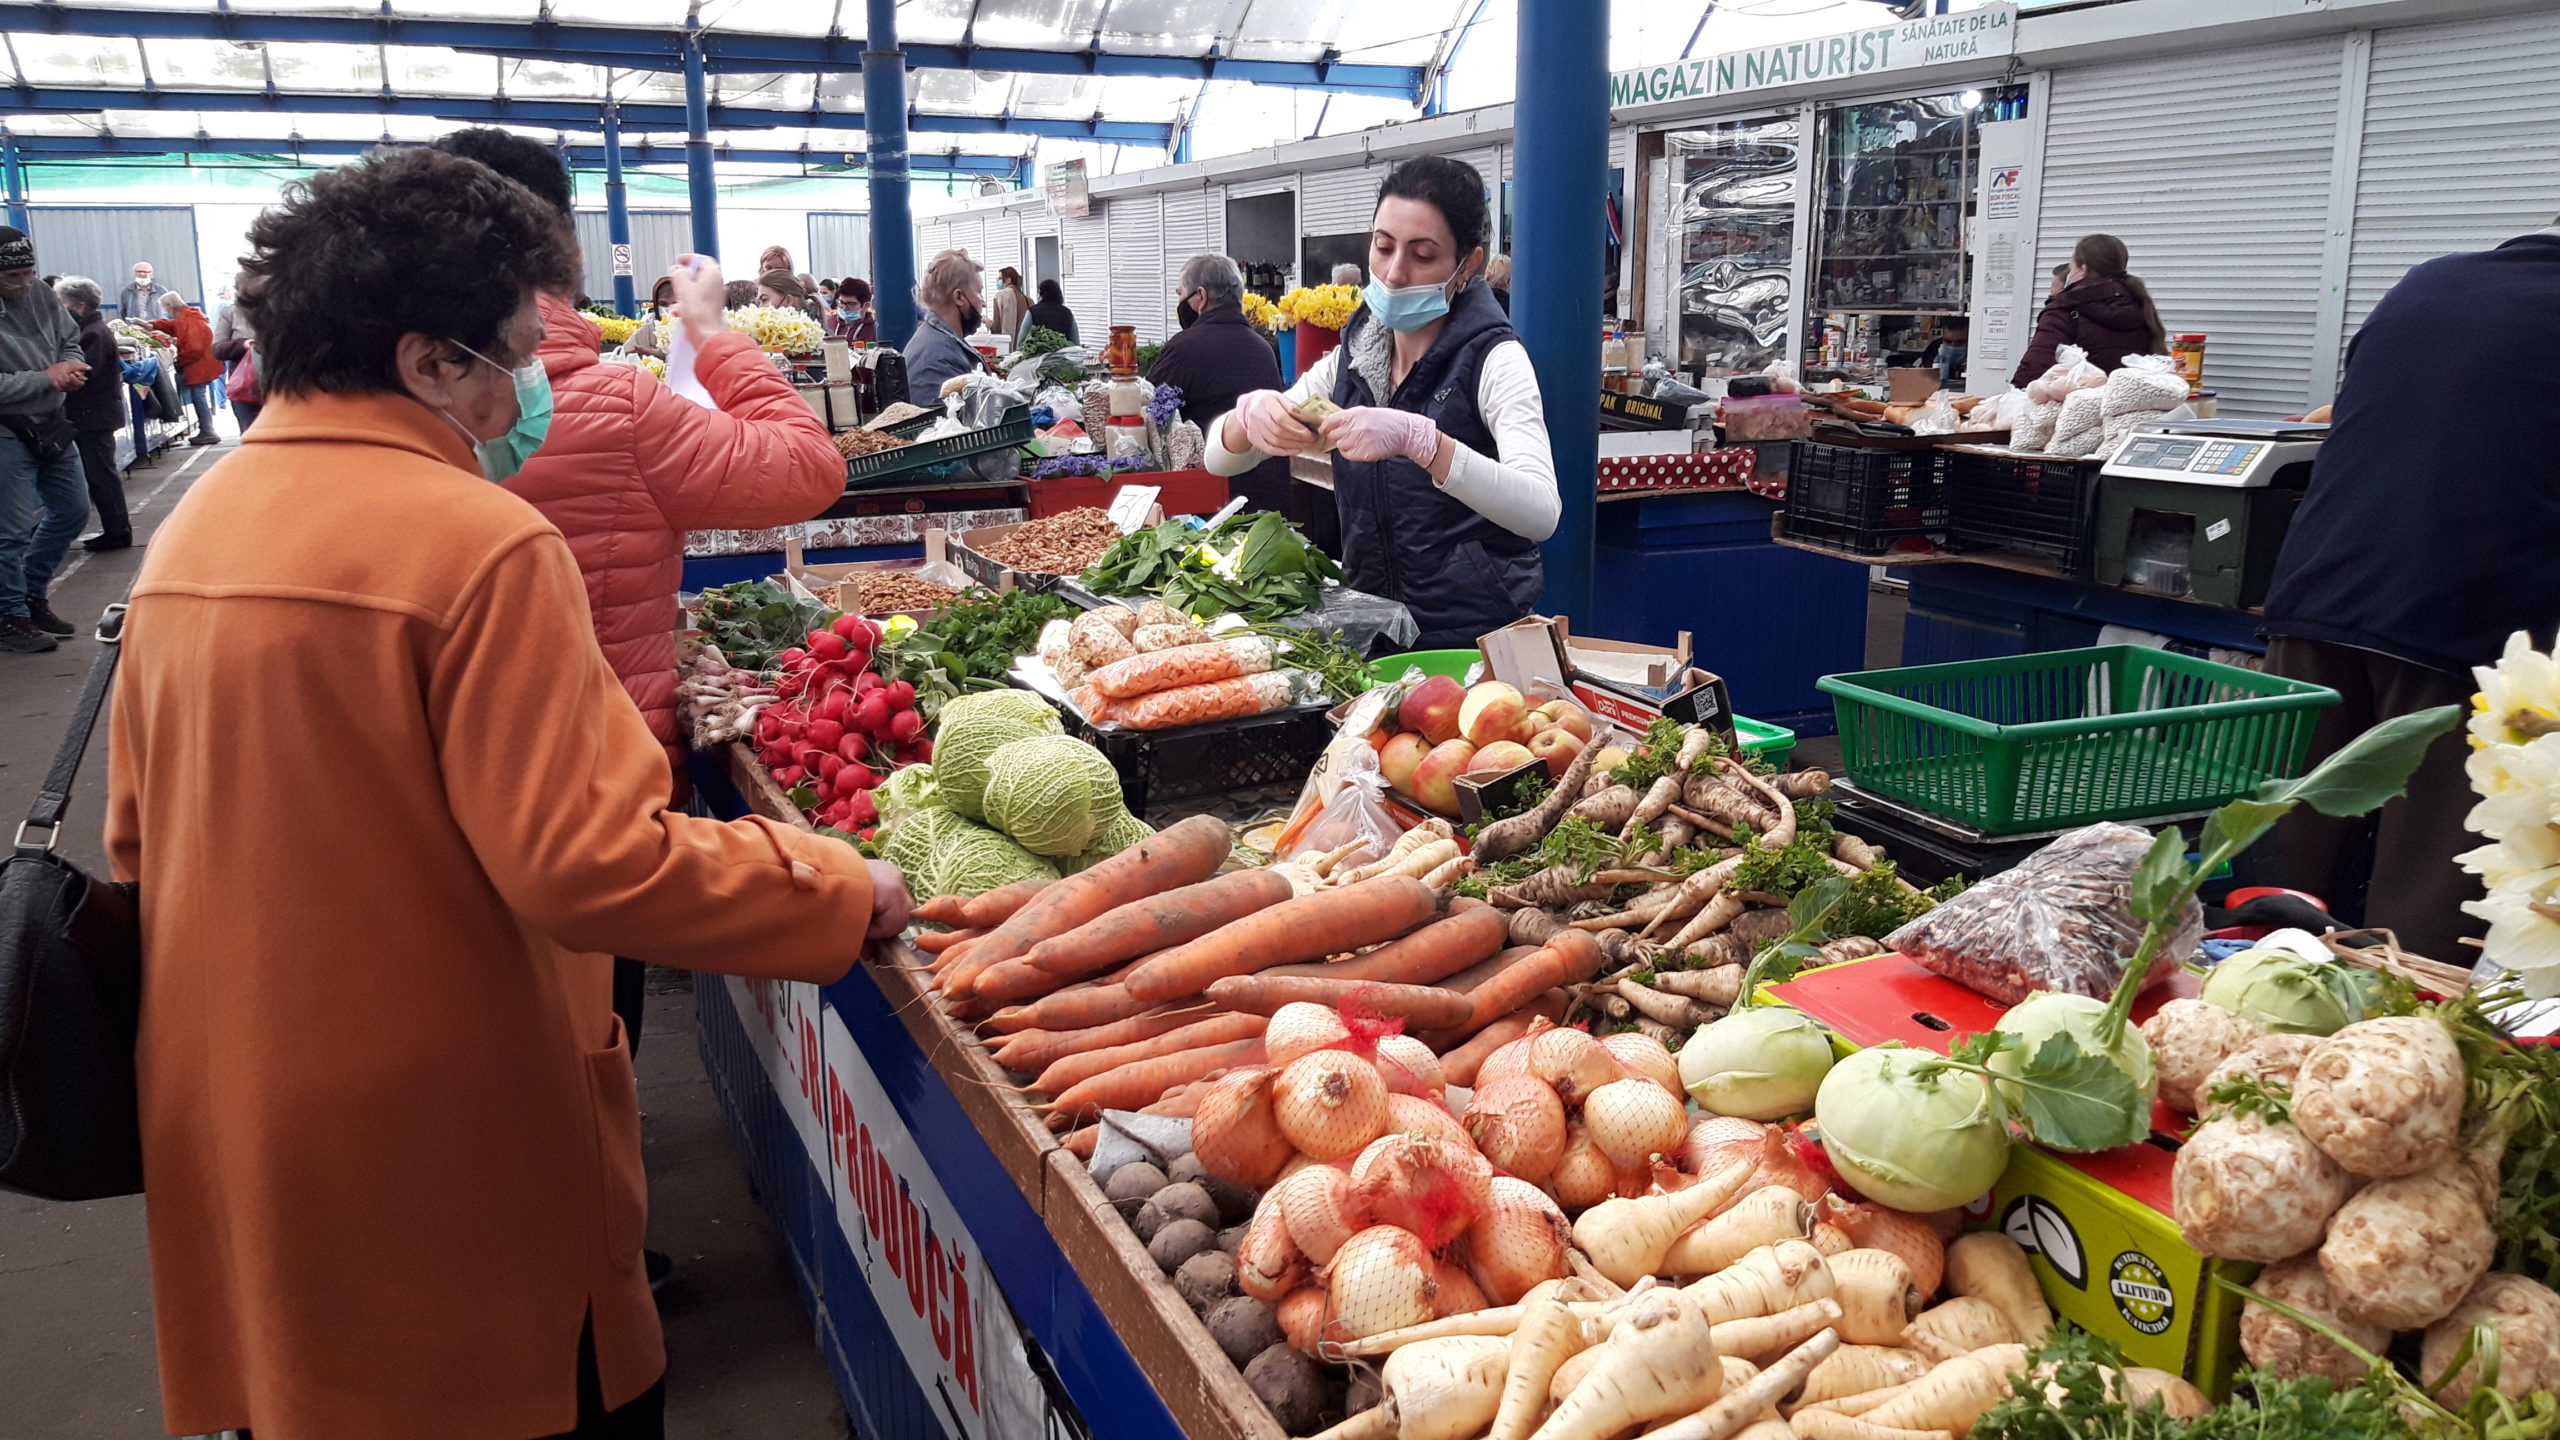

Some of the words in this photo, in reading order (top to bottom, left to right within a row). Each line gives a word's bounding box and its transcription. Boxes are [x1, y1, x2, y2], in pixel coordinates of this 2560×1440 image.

[1901, 19, 1965, 43] SĂNĂTATE
[1970, 15, 1986, 32] DE
[1990, 12, 2008, 28] LA
[1924, 36, 1978, 62] NATURĂ
[1611, 56, 1735, 107] MAGAZIN
[1745, 29, 1895, 88] NATURIST
[1624, 399, 1663, 420] ORIGINAL
[829, 1062, 980, 1417] PRODUCĂ
[2117, 1282, 2167, 1302] QUALITY
